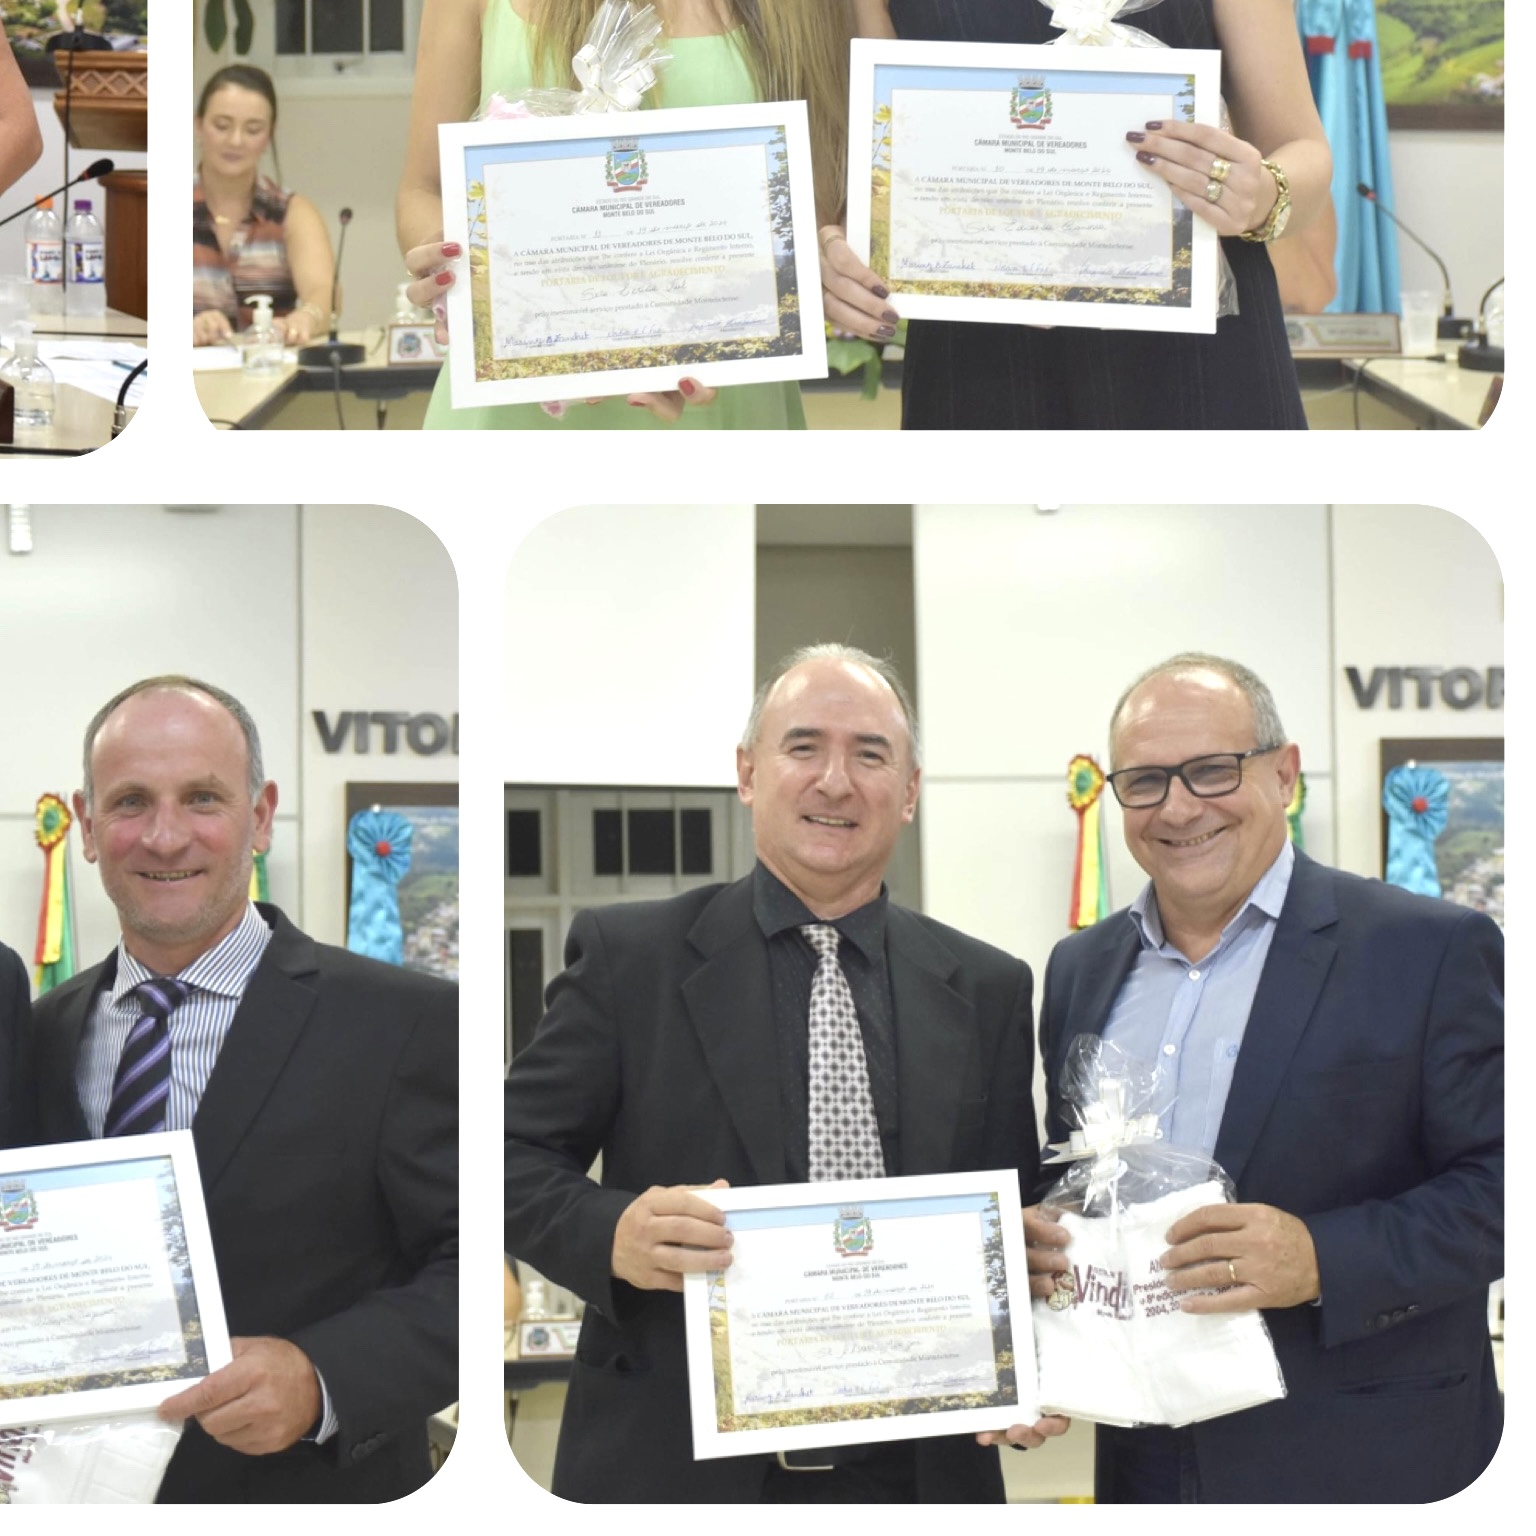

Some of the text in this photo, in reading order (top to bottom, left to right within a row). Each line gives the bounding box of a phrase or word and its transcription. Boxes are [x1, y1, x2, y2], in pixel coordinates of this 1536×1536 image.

[1002, 139, 1035, 147] MUNICIPAL
[1012, 178, 1060, 186] VEREADORES
[599, 202, 633, 211] MUNICIPAL
[635, 201, 642, 209] DE
[644, 198, 685, 208] VEREADORES
[556, 244, 597, 254] MUNICIPAL
[612, 239, 661, 249] VEREADORES
[675, 236, 701, 244] MONTE
[703, 234, 723, 242] BELO
[724, 233, 735, 241] DO
[311, 710, 459, 756] VITO
